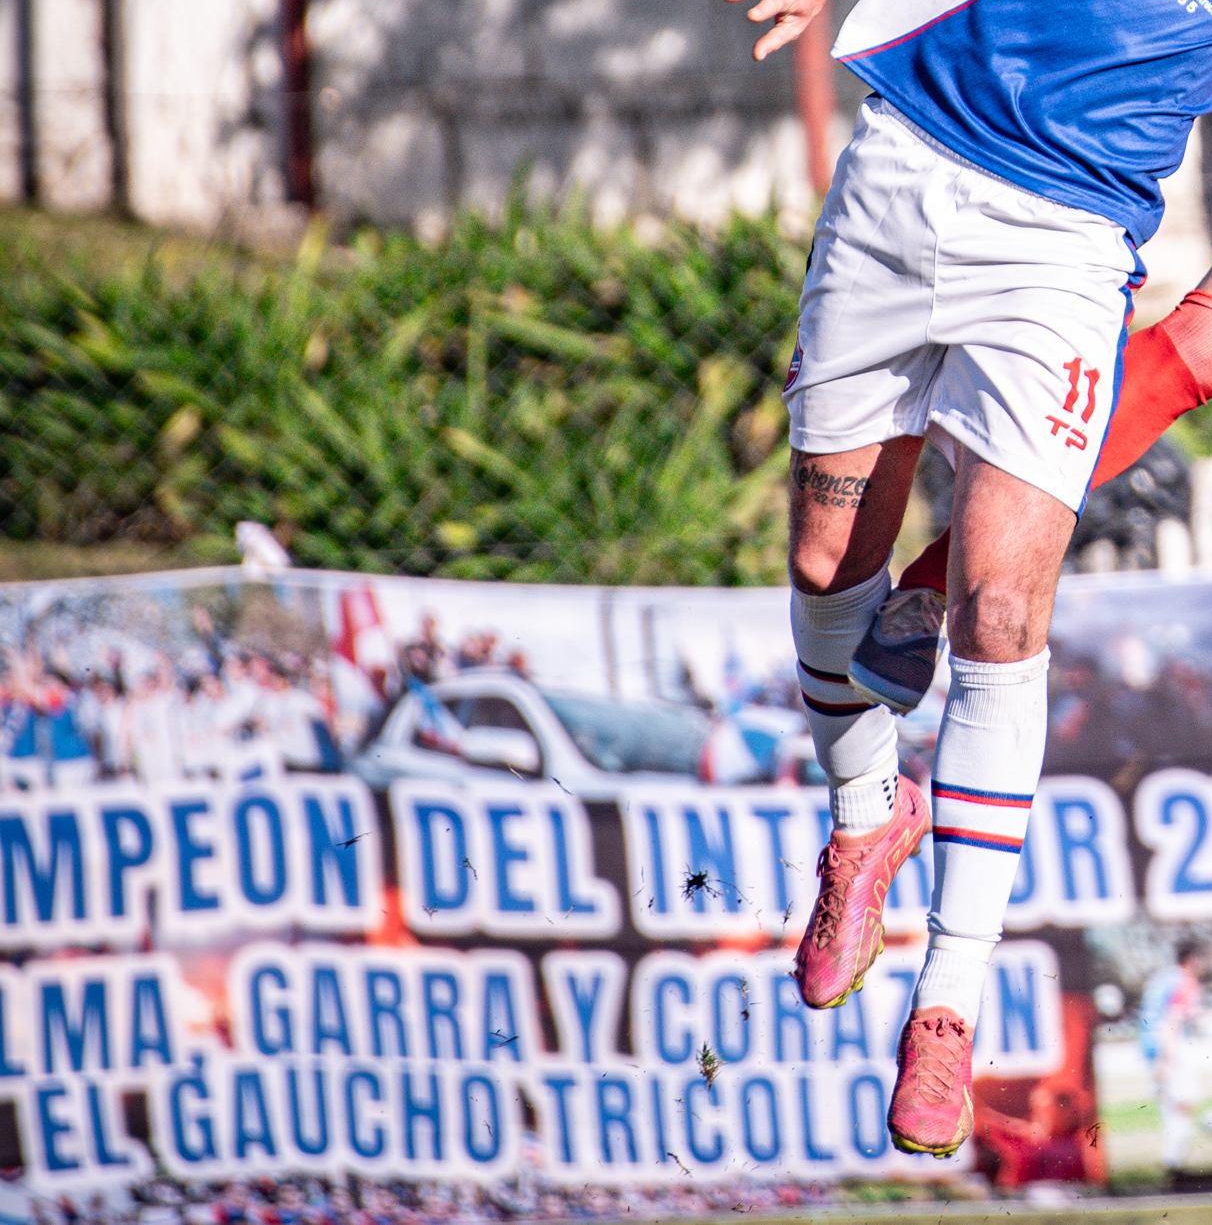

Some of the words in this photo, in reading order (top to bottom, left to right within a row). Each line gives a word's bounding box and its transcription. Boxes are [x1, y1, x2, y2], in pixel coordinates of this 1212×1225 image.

[1062, 356, 1101, 425] 11
[412, 800, 600, 913] DEL
[250, 963, 520, 1063] GARRA
[554, 967, 604, 1064] Y
[37, 1082, 131, 1171] EL
[169, 1068, 504, 1163] GAUCHO
